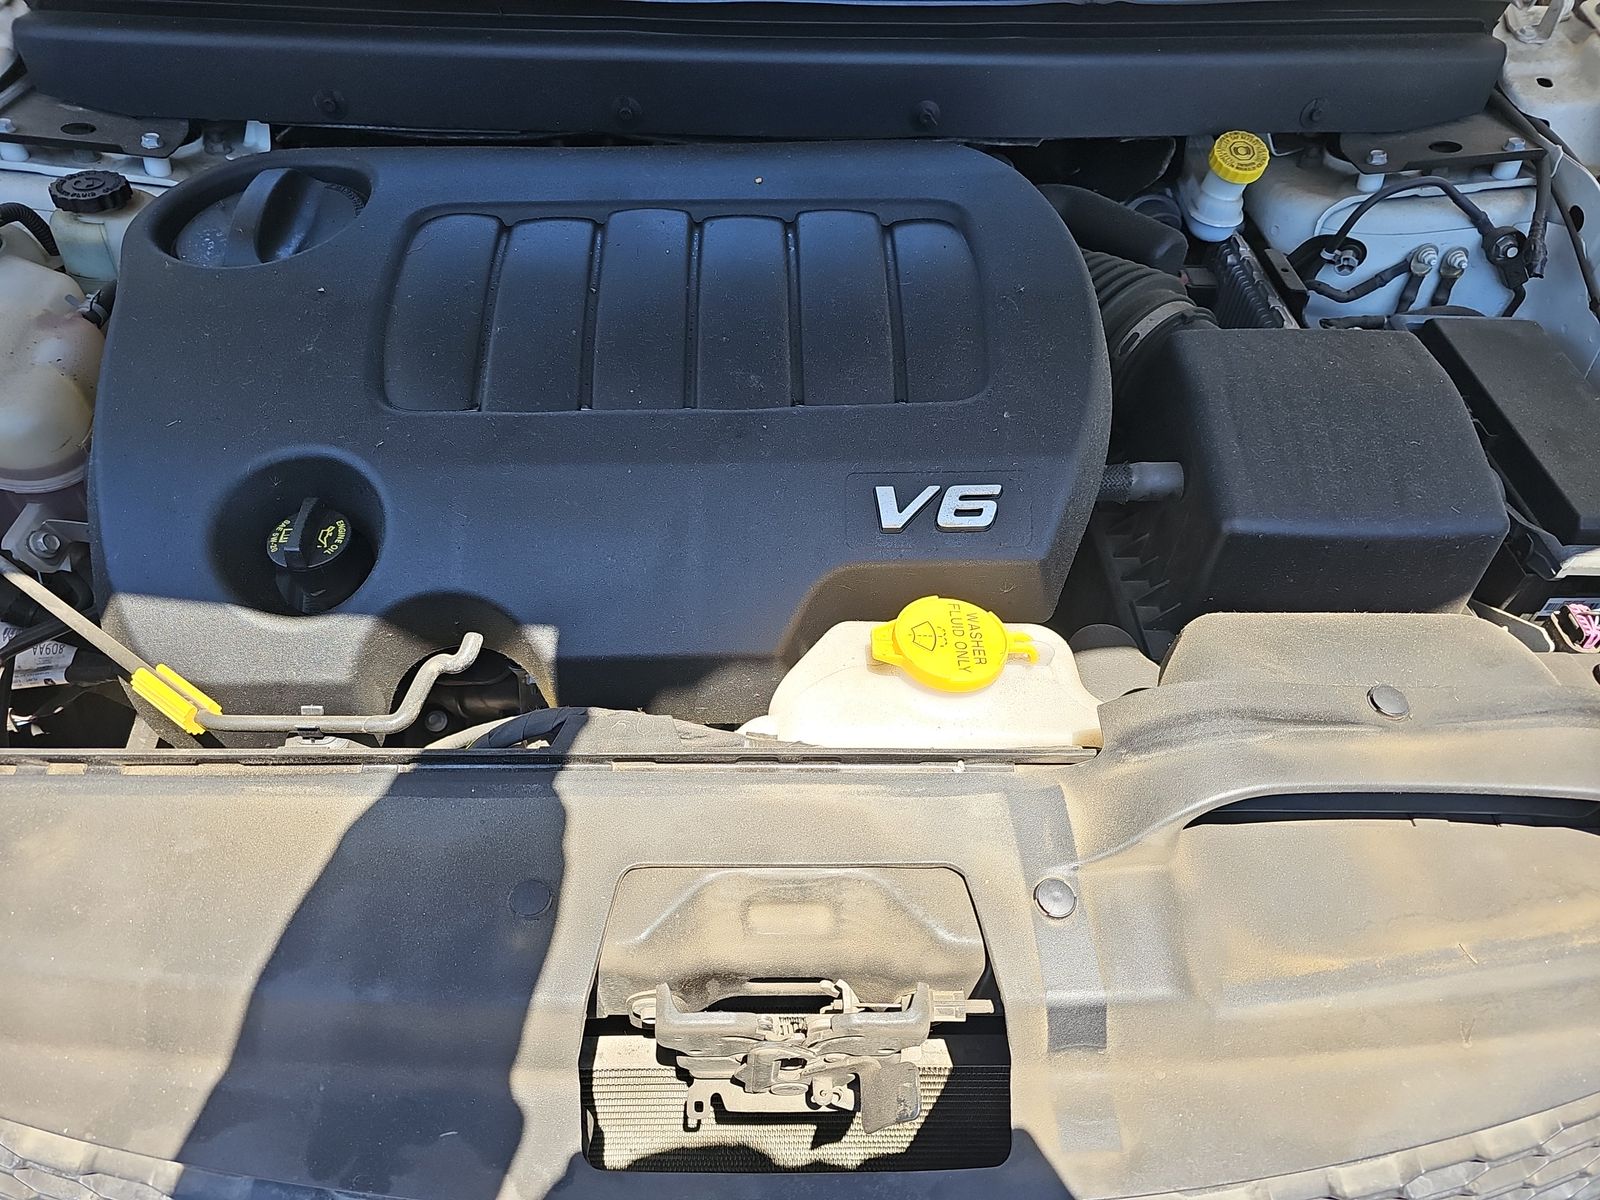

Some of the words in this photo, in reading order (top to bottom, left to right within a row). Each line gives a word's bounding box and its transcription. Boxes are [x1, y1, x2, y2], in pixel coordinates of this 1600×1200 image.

[873, 484, 1002, 531] V6
[334, 519, 347, 544] ENGINE
[323, 544, 339, 555] OIL
[948, 603, 965, 637] FLUID
[32, 642, 66, 656] 809AA
[966, 612, 988, 665] WASHER
[954, 641, 972, 673] ONLY
